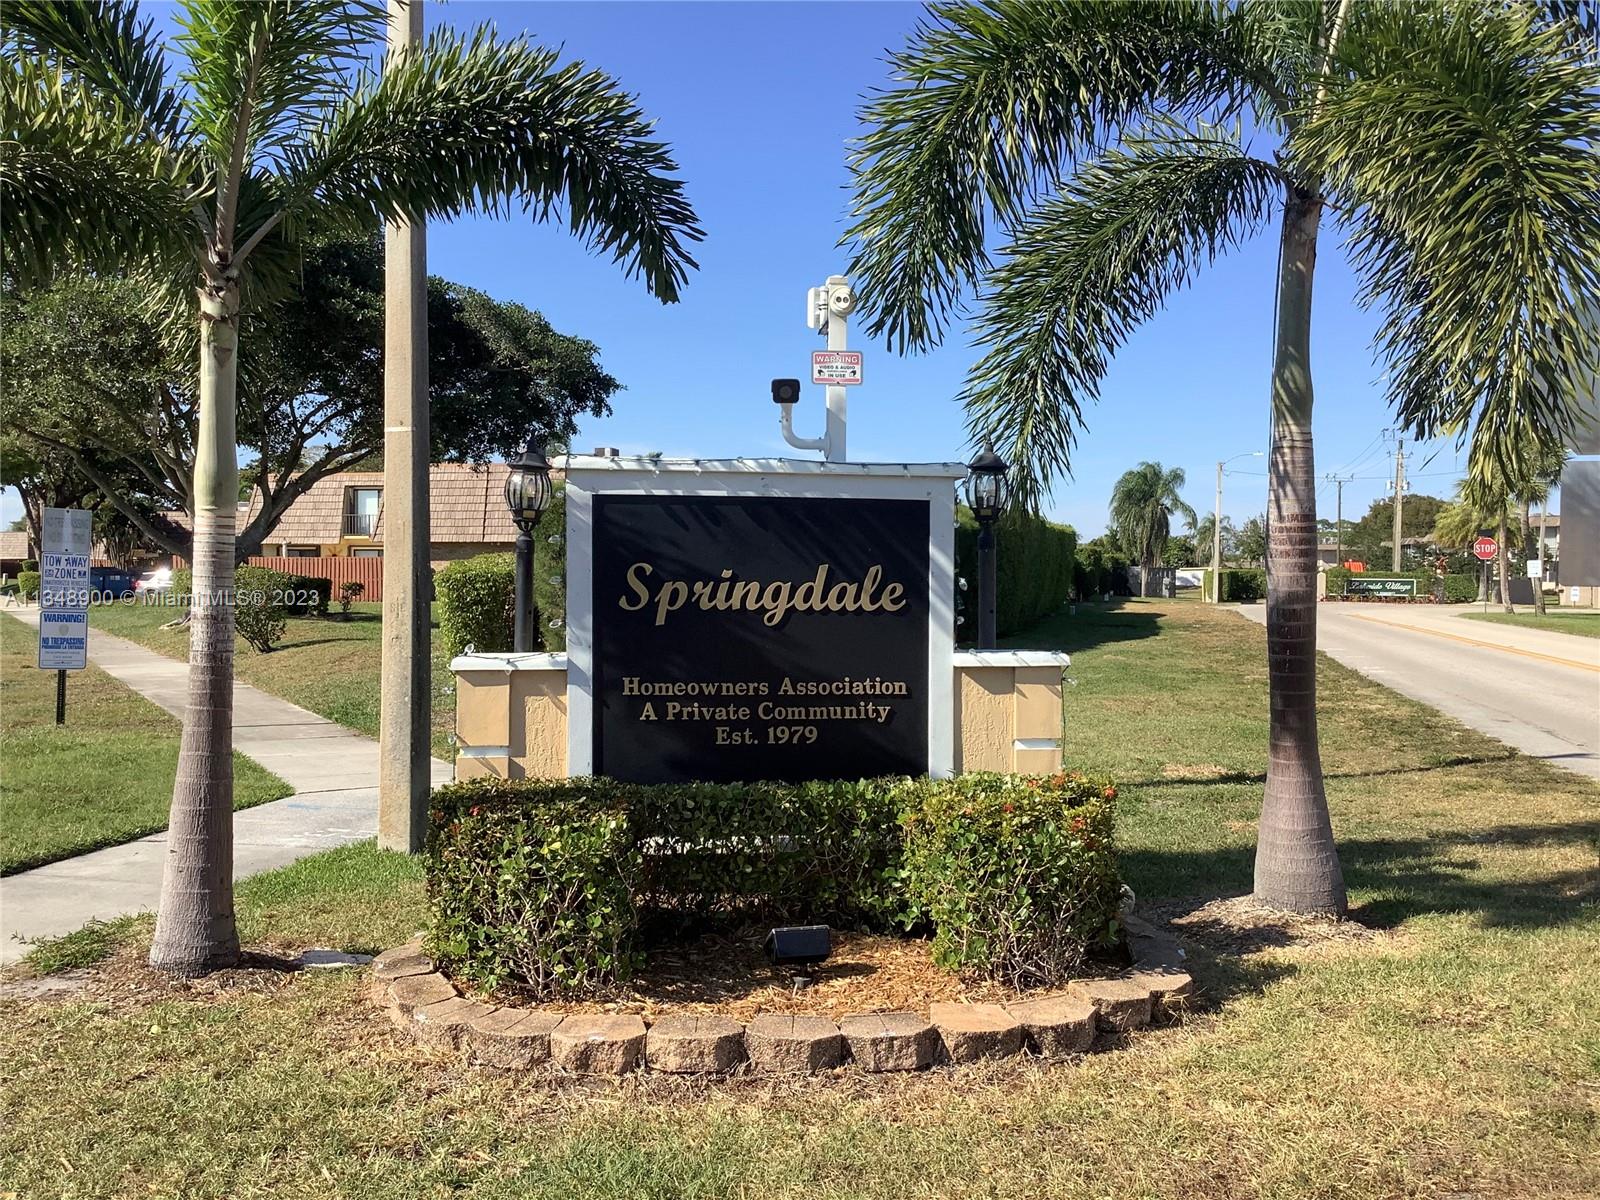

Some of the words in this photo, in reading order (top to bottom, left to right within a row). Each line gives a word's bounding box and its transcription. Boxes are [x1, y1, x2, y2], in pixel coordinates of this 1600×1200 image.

[1475, 545, 1496, 553] STOP
[44, 555, 62, 567] TOW
[66, 556, 88, 568] AWAY
[54, 568, 77, 579] ZONE
[1385, 581, 1412, 592] Village
[618, 562, 907, 627] Springdale
[43, 613, 85, 623] WARNING!
[42, 637, 49, 645] NO
[51, 637, 84, 645] TRESPASSING
[622, 676, 769, 696] Homeowners
[777, 676, 908, 696] Association
[639, 702, 657, 721] A
[665, 702, 751, 721] Private
[757, 701, 891, 723] Community
[715, 726, 759, 745] Est.
[767, 726, 818, 745] 1979
